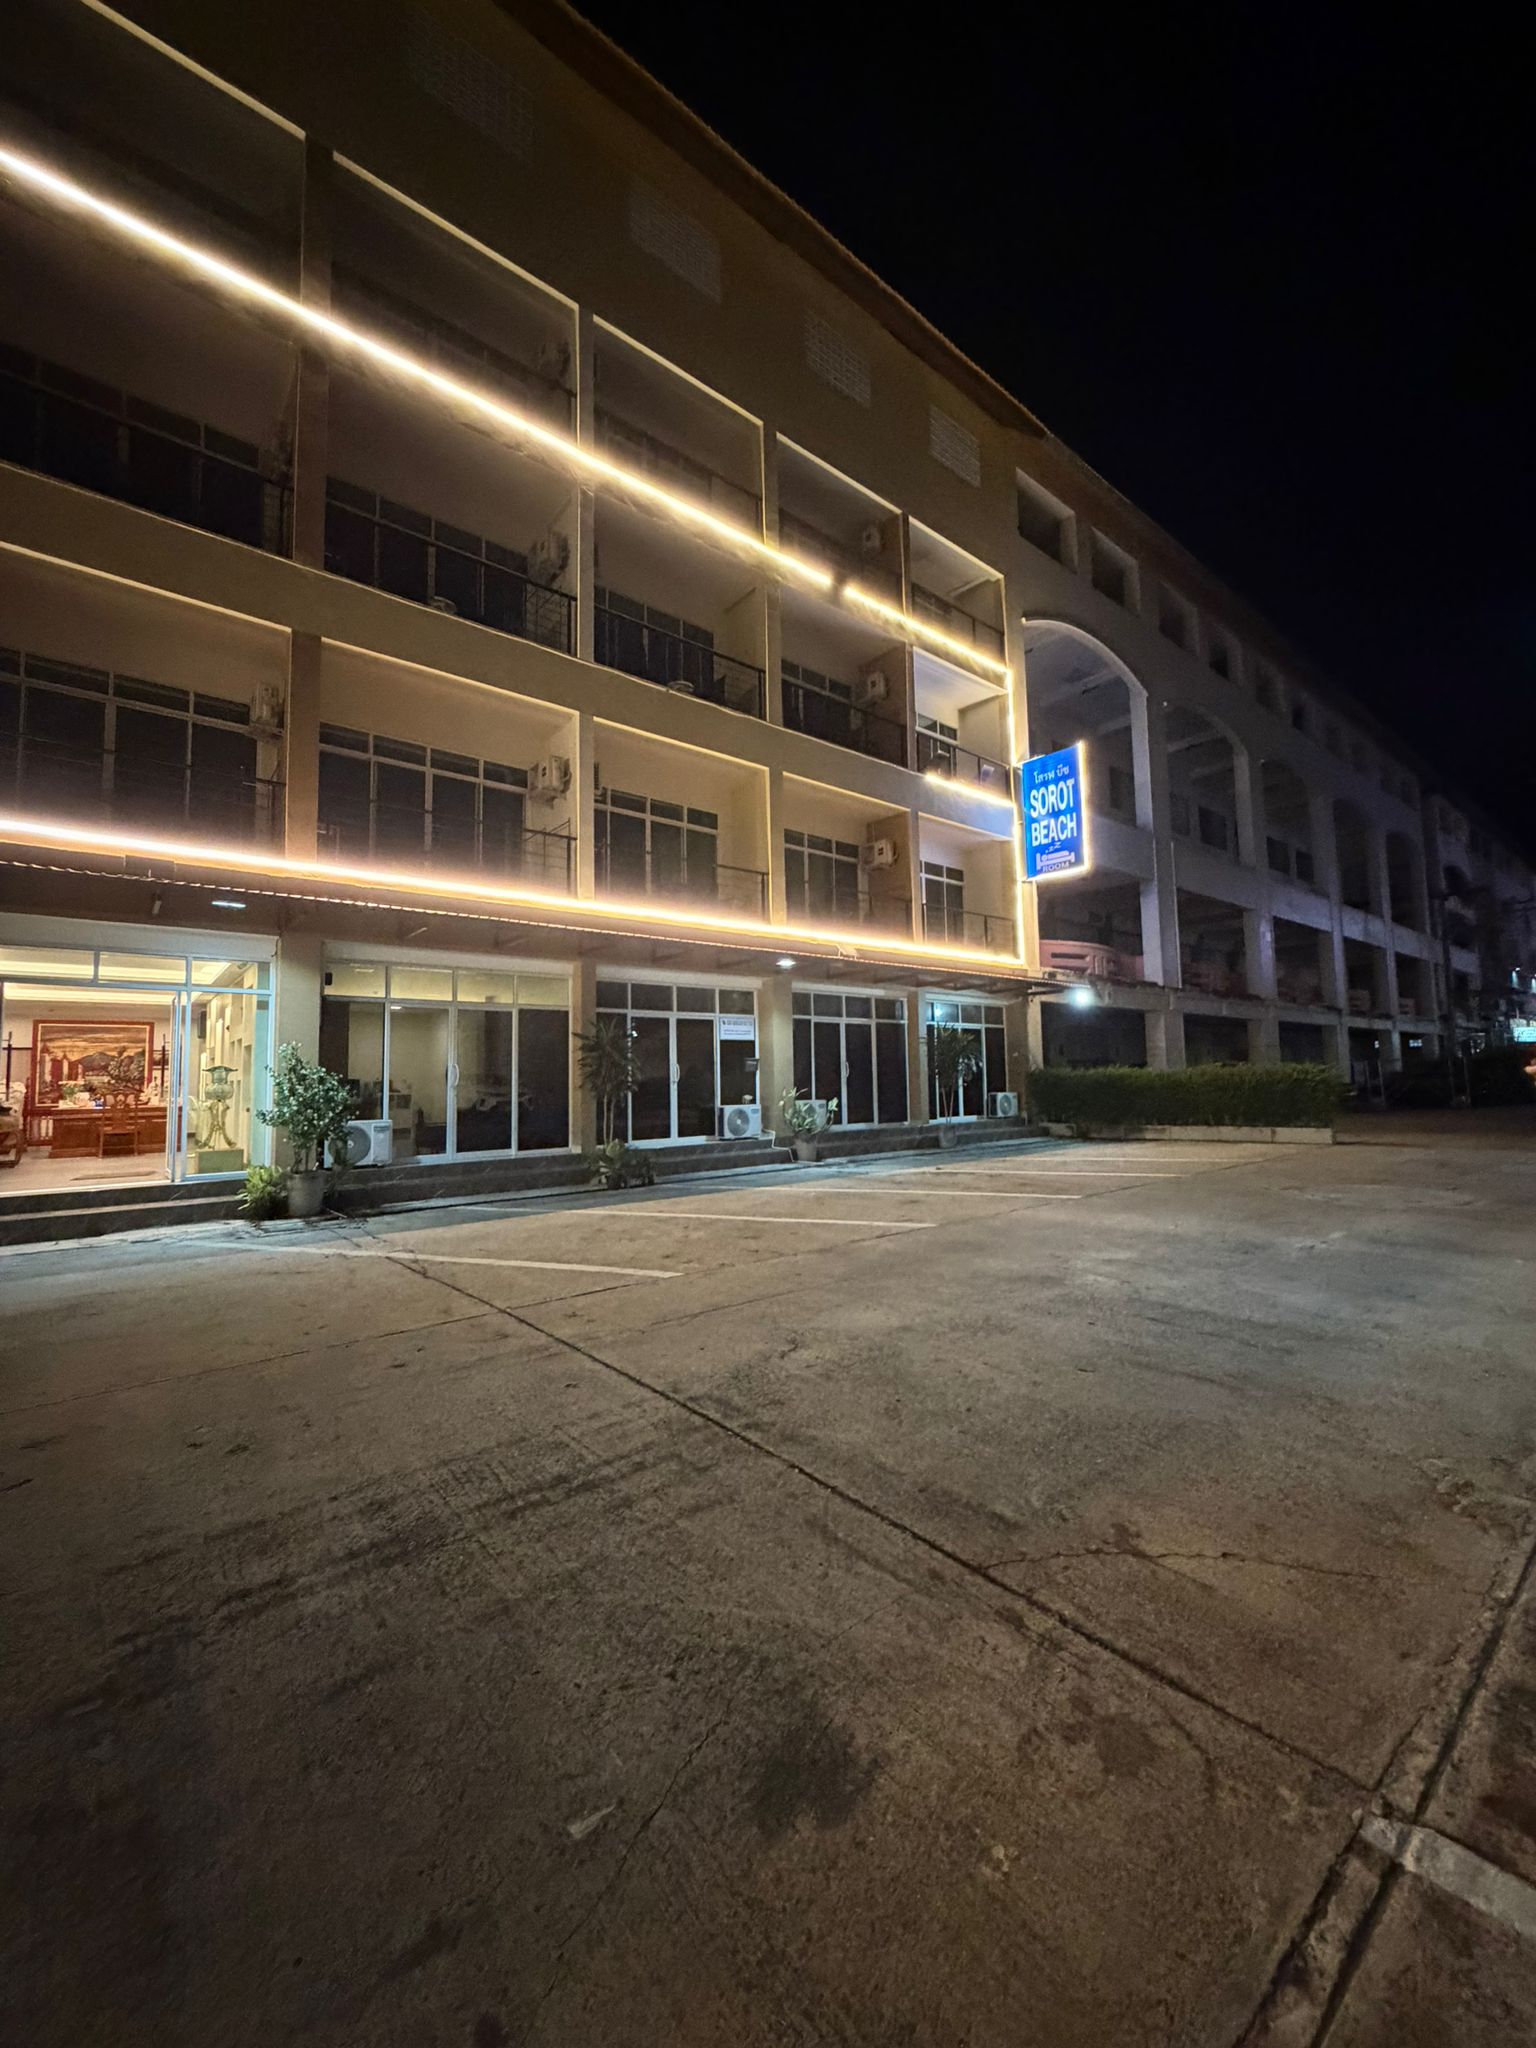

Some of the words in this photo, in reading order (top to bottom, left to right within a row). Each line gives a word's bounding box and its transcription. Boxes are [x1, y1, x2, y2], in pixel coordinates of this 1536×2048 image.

[1030, 778, 1075, 818] SOROT
[1031, 812, 1077, 846] BEACH
[1042, 861, 1070, 873] ROOM
